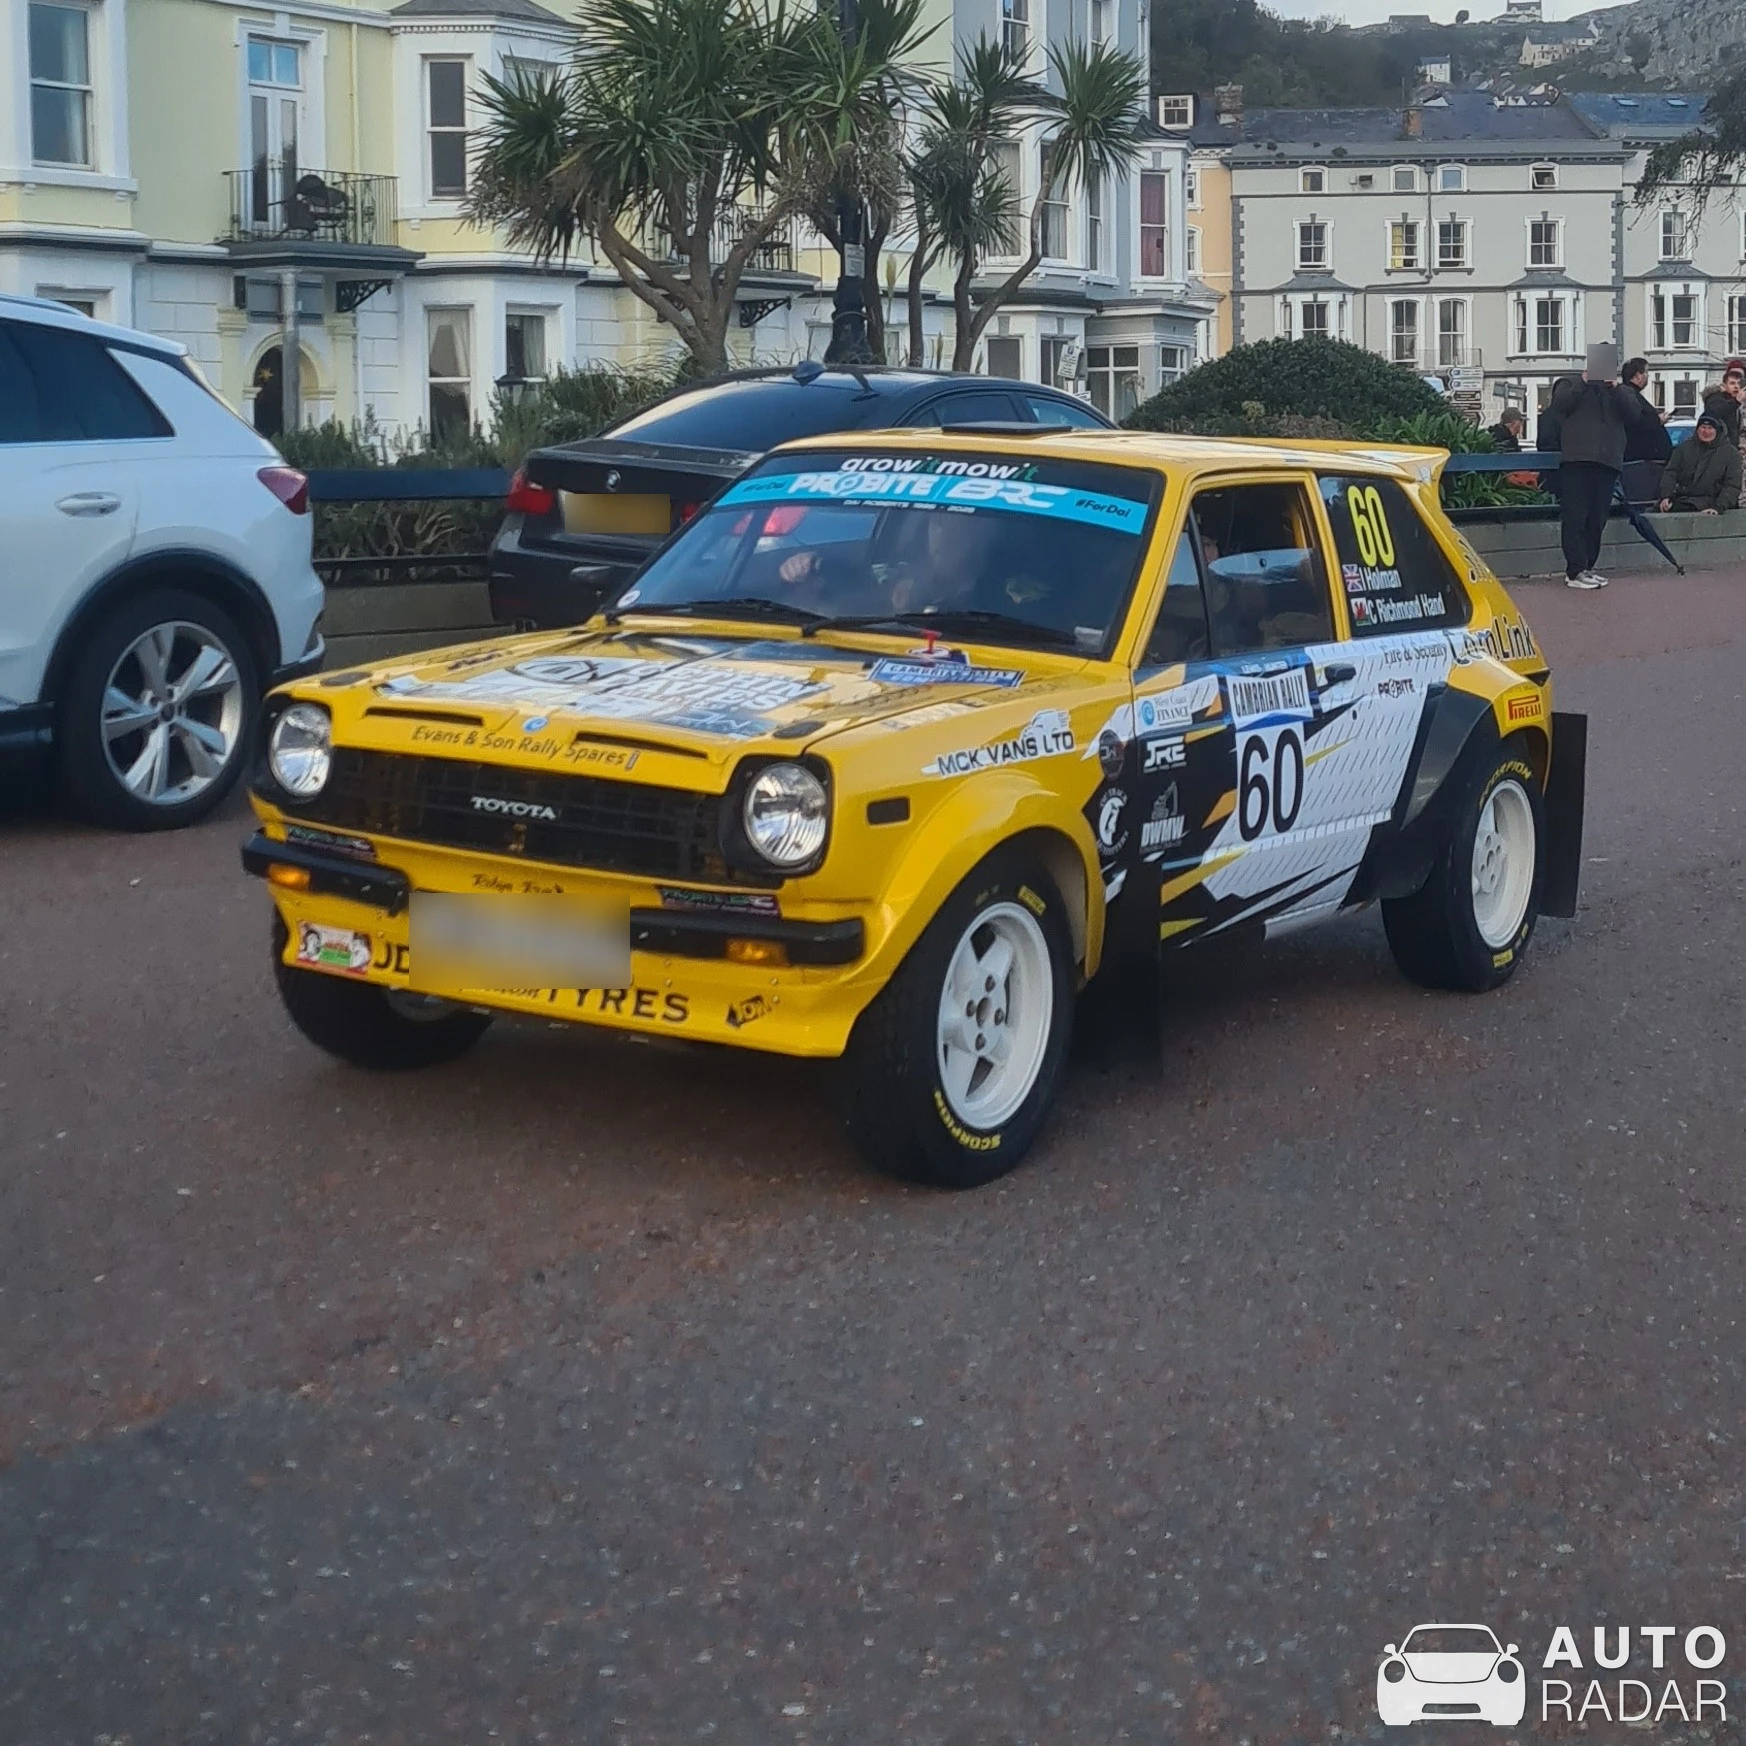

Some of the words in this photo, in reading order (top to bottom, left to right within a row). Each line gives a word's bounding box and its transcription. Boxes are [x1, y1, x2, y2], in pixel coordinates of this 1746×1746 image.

[945, 478, 1071, 509] BRC
[1347, 485, 1395, 567] 60
[1363, 566, 1402, 591] Holman
[1368, 600, 1378, 624] C
[1375, 594, 1424, 623] Richmond
[1420, 591, 1446, 617] Hand
[1232, 680, 1281, 718] CAMBRIAN
[1279, 675, 1307, 709] RALLY
[1508, 694, 1542, 720] PIRELLI
[412, 725, 462, 744] Evans
[464, 730, 478, 745] &
[481, 732, 514, 750] Son
[518, 736, 564, 760] Rally
[565, 743, 627, 765] Spares
[937, 749, 983, 776] MCK
[986, 737, 1038, 765] VANS
[1043, 731, 1074, 753] LTD
[1239, 728, 1304, 842] 60
[470, 797, 557, 820] TOYOTA
